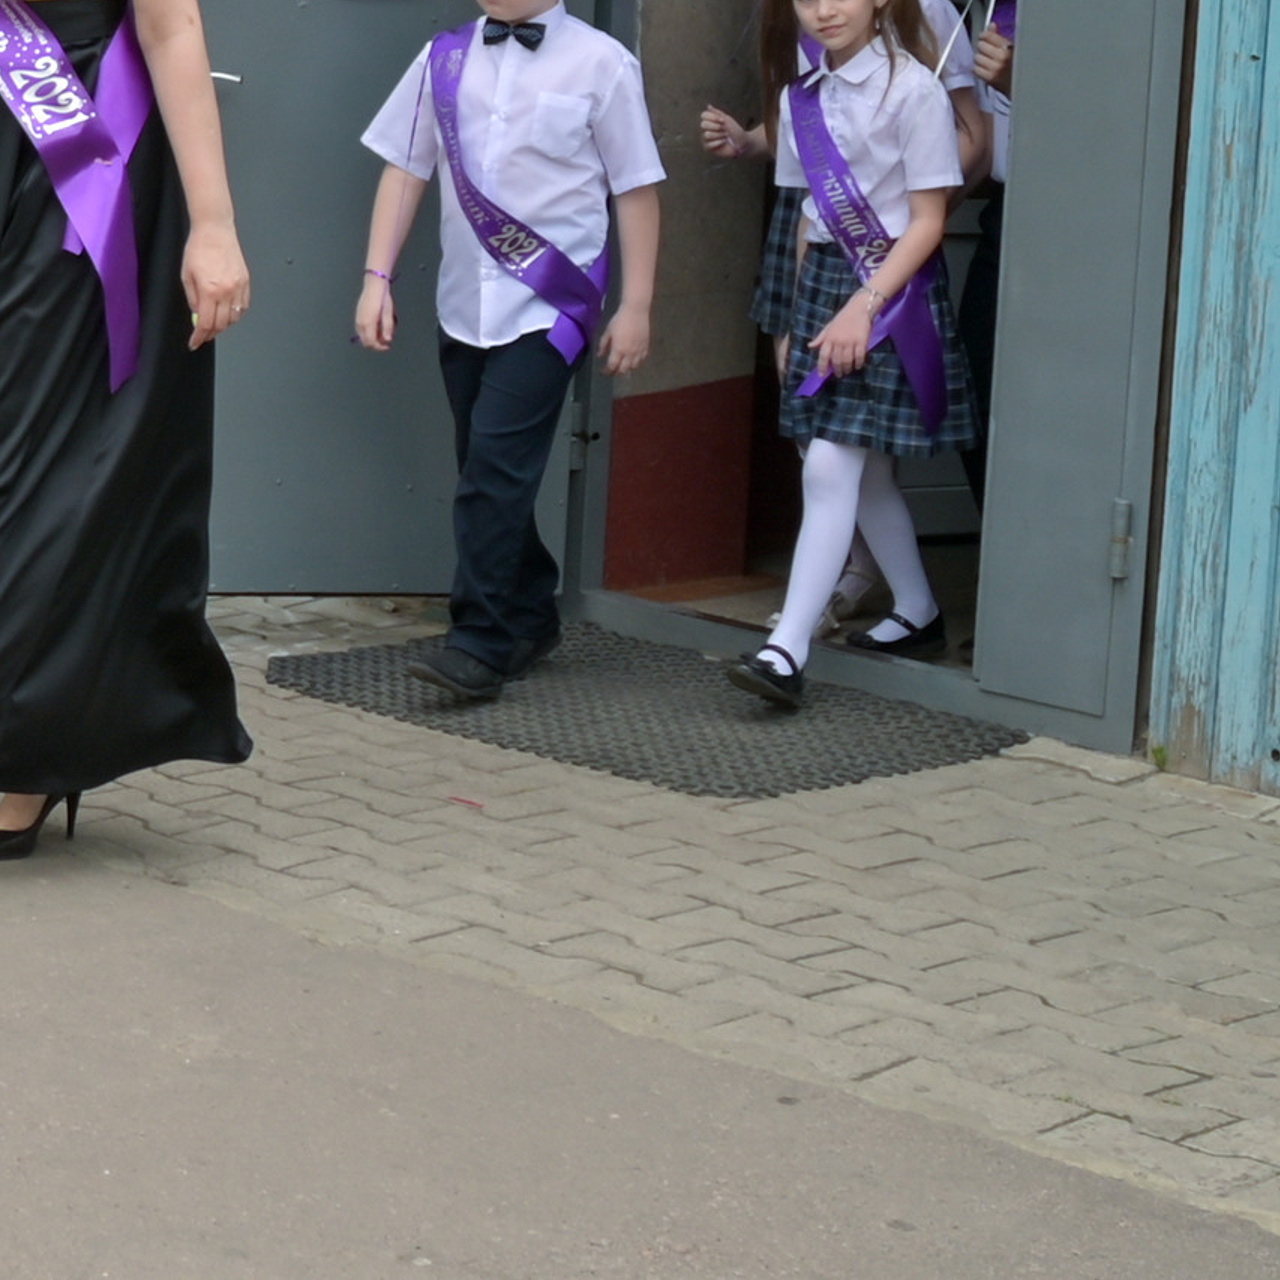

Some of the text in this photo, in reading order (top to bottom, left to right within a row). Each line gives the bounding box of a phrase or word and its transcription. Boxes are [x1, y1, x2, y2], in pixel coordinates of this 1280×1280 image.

[9, 56, 90, 136] 2021
[488, 223, 547, 269] 2021
[855, 238, 888, 276] 20
